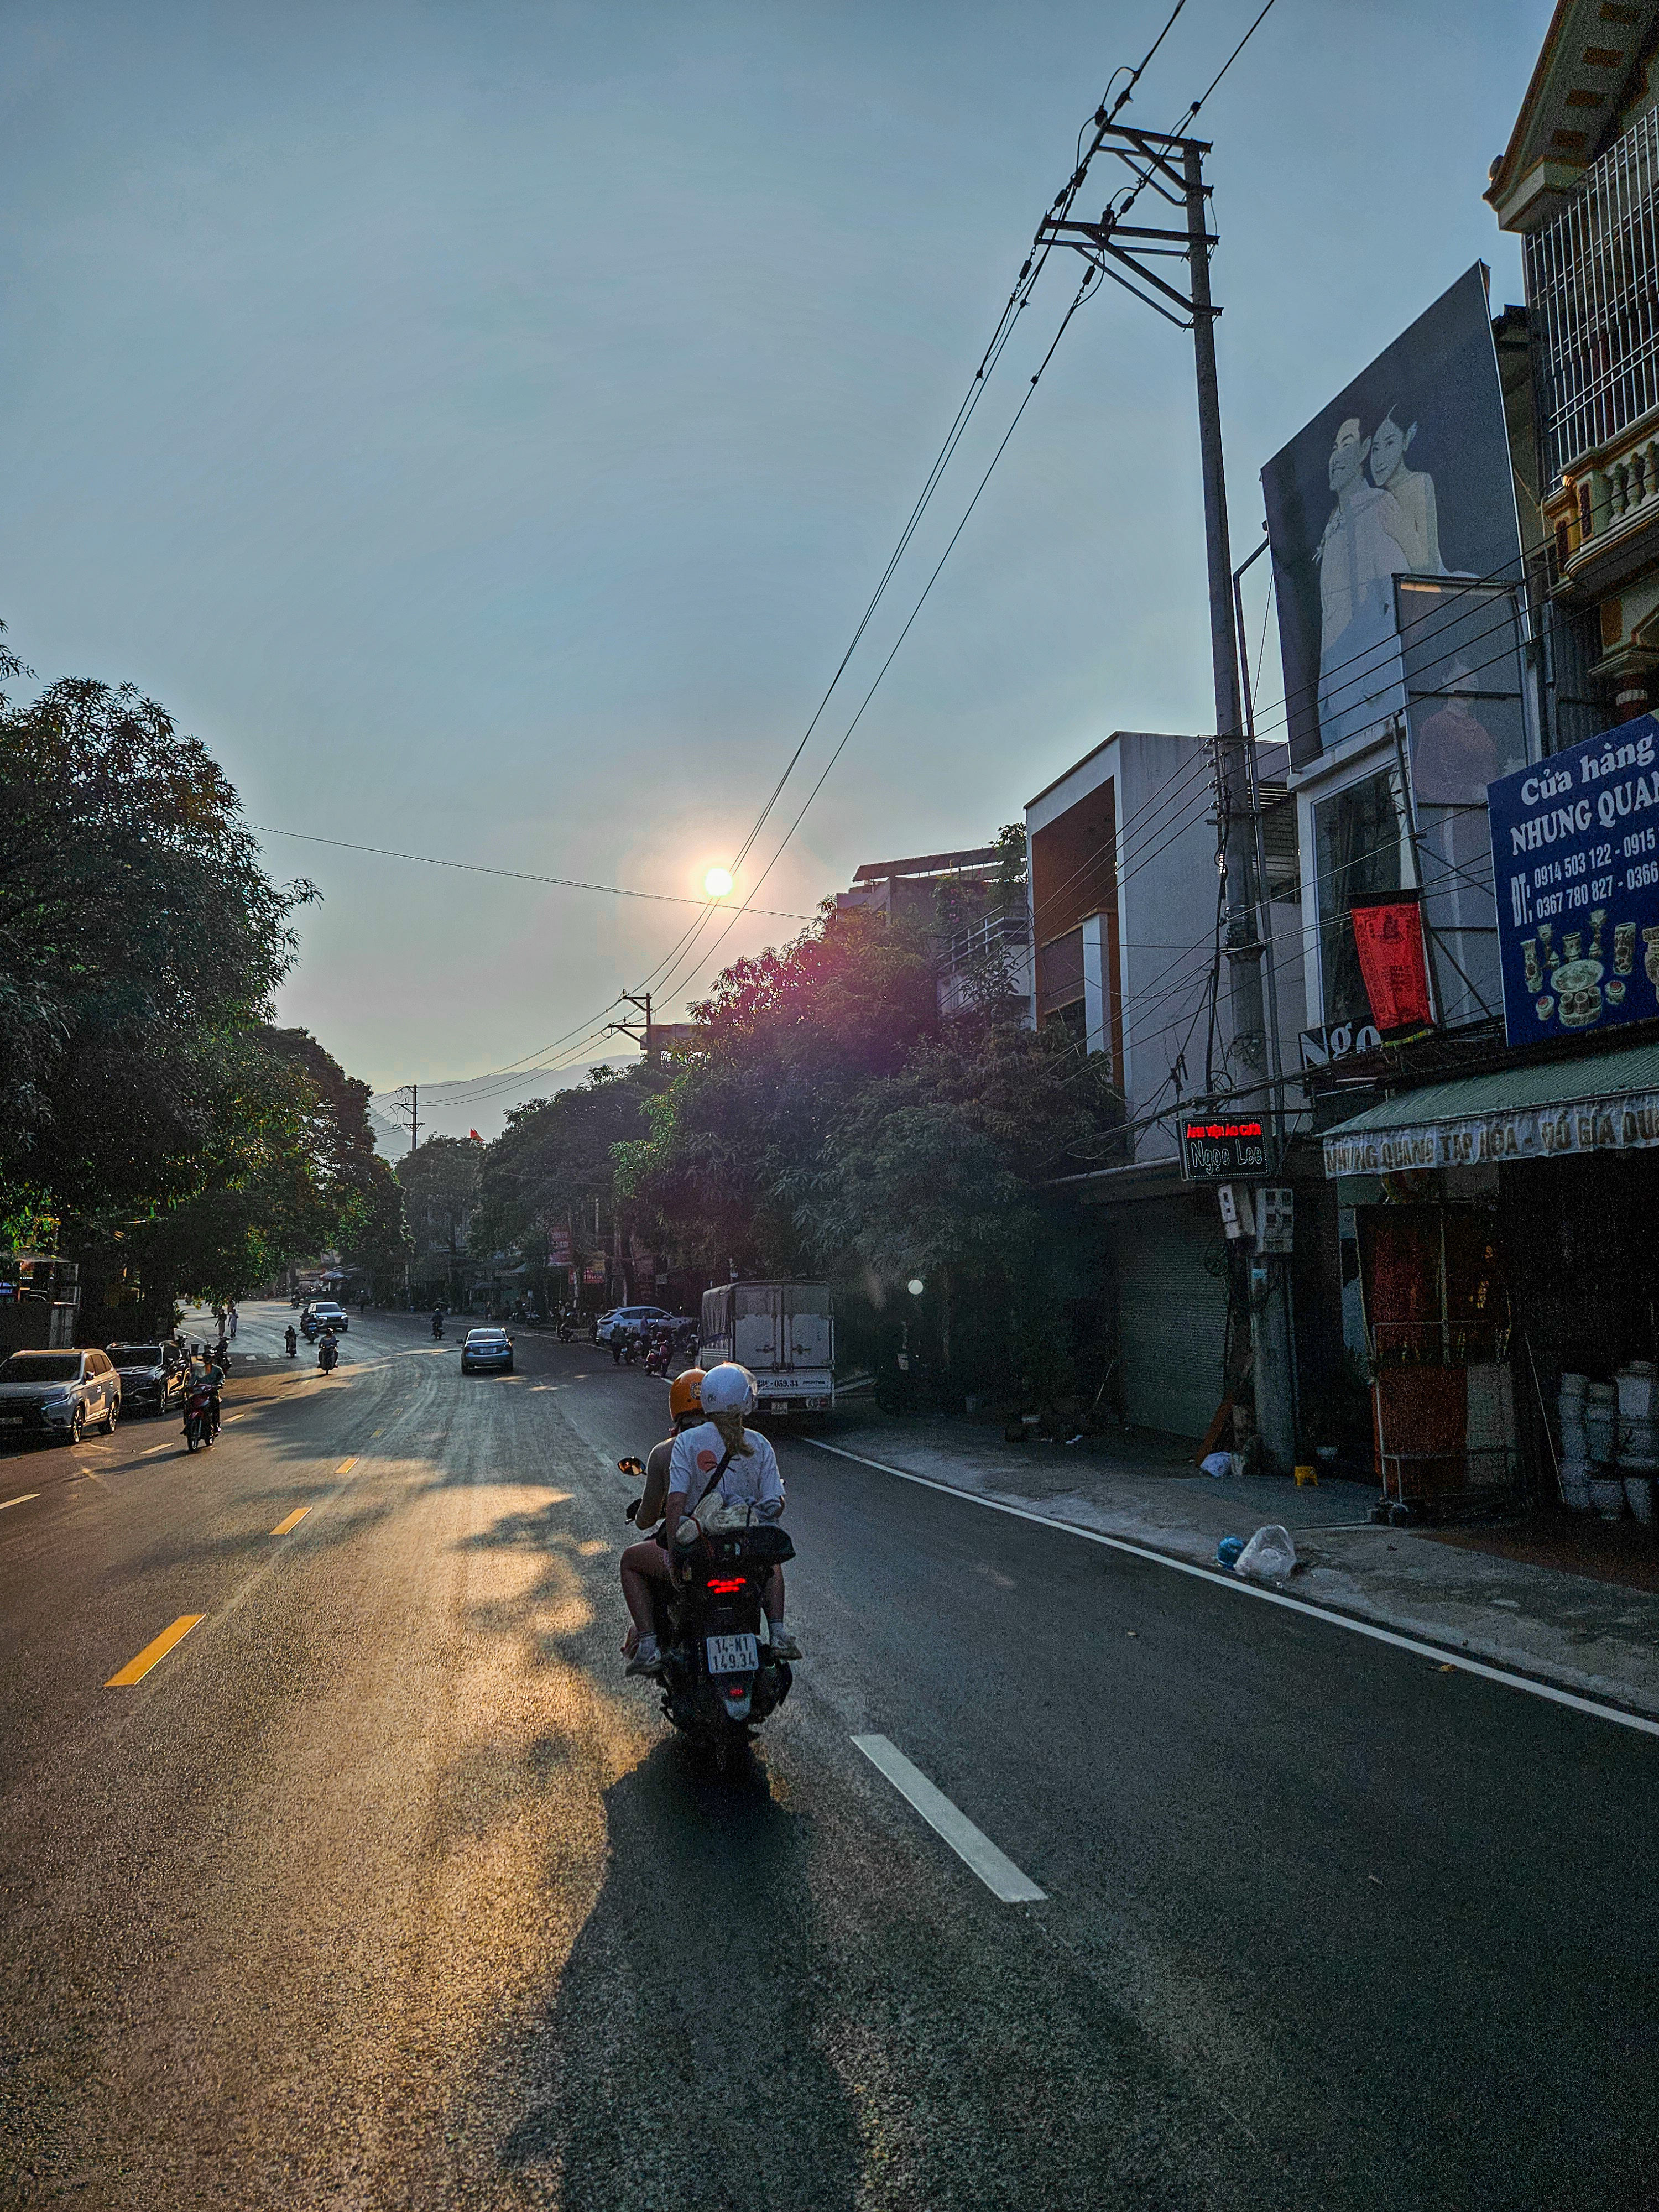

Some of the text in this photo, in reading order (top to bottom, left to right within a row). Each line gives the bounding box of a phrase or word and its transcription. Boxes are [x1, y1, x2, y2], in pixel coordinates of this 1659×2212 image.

[1521, 733, 1655, 805] Cửa hàng
[1510, 799, 1592, 855] NHUNG
[1535, 862, 1562, 888] 0914
[1564, 852, 1585, 878] 503
[1589, 843, 1611, 869] 122
[1623, 827, 1656, 857] 0915
[1536, 891, 1563, 919] 0367
[1566, 884, 1588, 909] 780
[1592, 875, 1613, 901] 827
[1626, 860, 1659, 890] 0366
[1191, 1139, 1263, 1175] Ngọc Lee
[1326, 1145, 1378, 1172] NHUNG
[1382, 1137, 1434, 1168] QUANG
